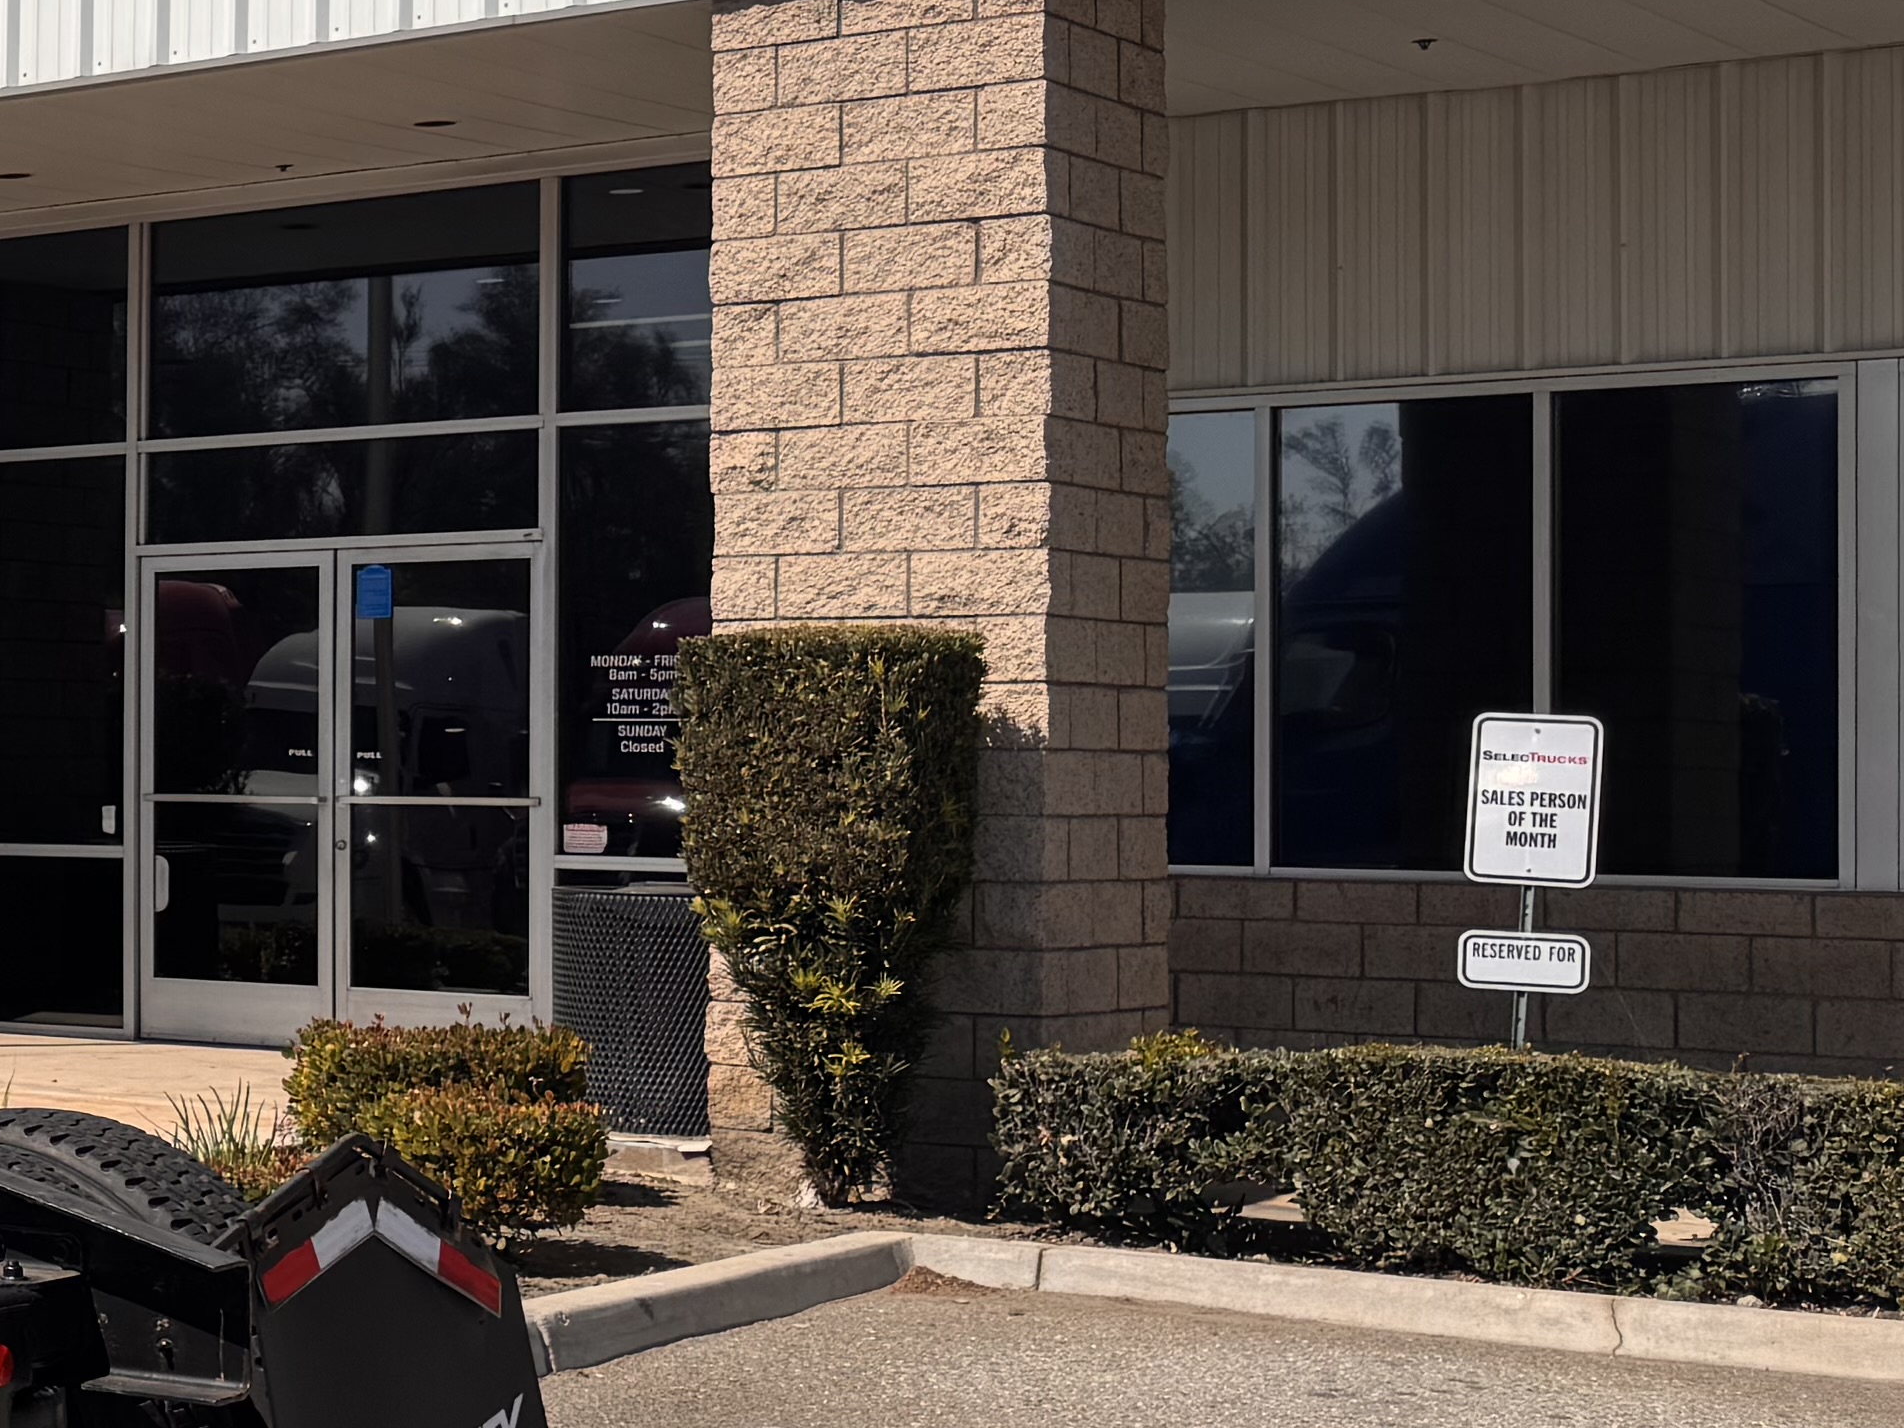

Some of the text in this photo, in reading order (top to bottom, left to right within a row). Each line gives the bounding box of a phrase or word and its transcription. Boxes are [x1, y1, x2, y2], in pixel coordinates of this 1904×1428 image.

[590, 655, 642, 668] MONDAY
[609, 669, 637, 681] 8am
[649, 669, 678, 682] 5pm
[612, 688, 670, 701] SATURDA
[606, 703, 639, 715] 10am
[617, 725, 667, 737] SUNDAY
[620, 740, 665, 753] Closed
[1481, 789, 1587, 810] SALES PERSON
[1507, 811, 1557, 829] OF THE
[1505, 830, 1557, 849] MONTH
[1472, 942, 1576, 963] RESERVED FOR
